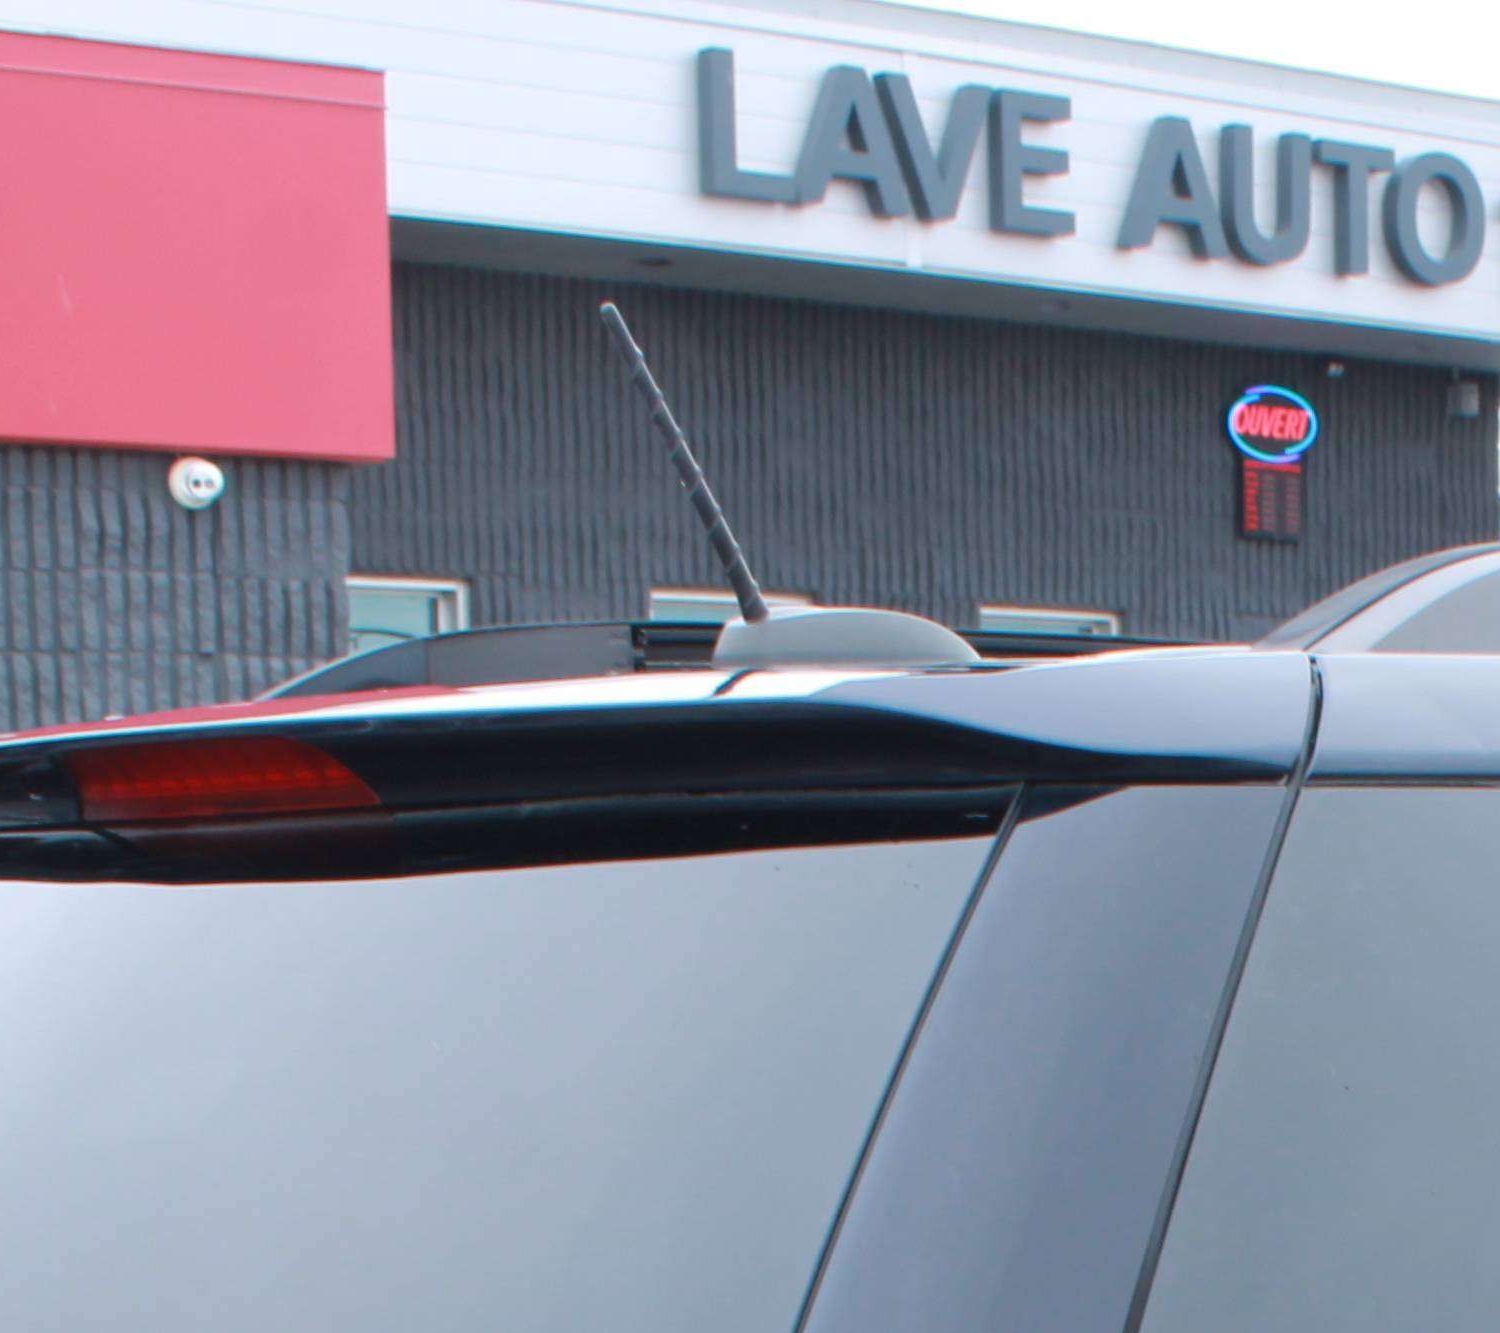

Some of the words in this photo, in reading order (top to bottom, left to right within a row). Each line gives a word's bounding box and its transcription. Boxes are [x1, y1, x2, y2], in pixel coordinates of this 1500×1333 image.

[696, 46, 1077, 239] LAVE
[1117, 114, 1486, 287] AUTO
[1234, 404, 1310, 441] OUVERT
